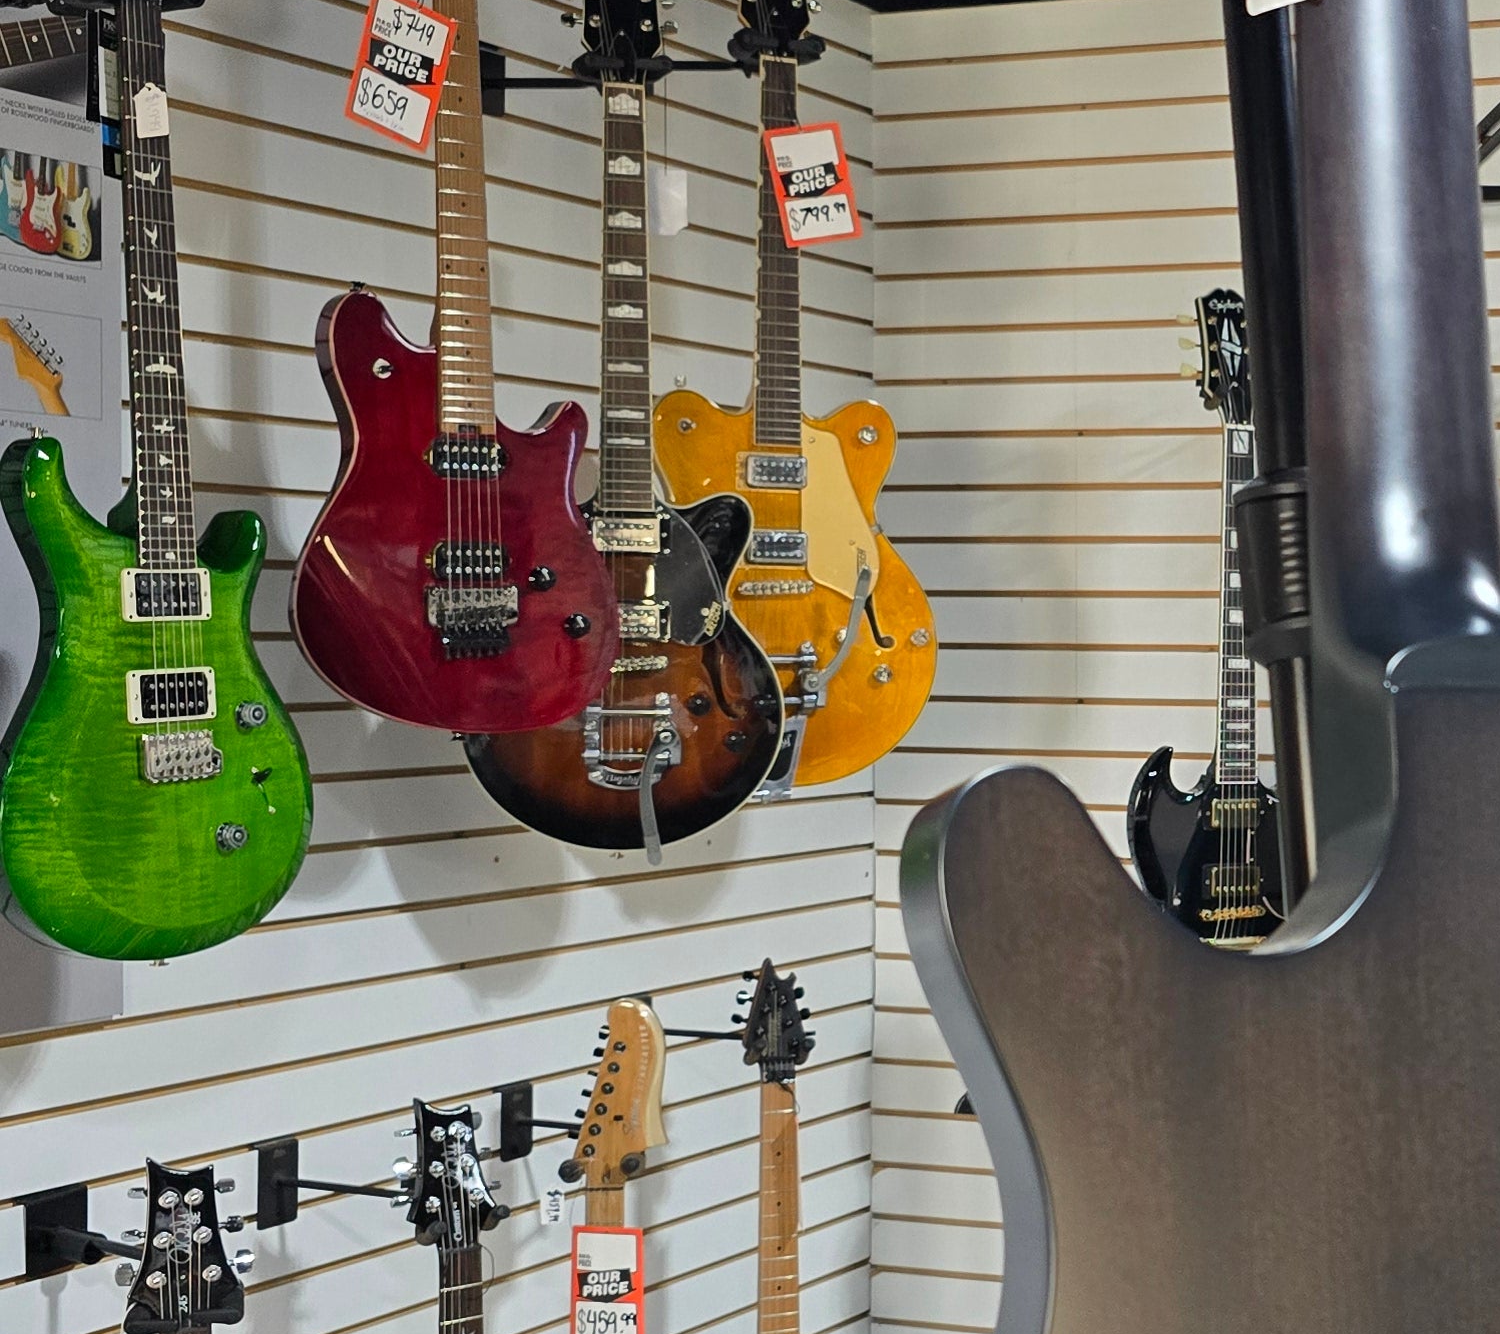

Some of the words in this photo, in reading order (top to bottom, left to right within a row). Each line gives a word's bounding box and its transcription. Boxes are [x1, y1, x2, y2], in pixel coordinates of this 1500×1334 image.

[374, 22, 392, 38] PRICE
[393, 6, 435, 46] $749
[382, 44, 422, 68] OUR
[373, 54, 429, 83] PRICE
[358, 76, 409, 121] $659
[788, 174, 836, 197] PRICE
[791, 165, 826, 184] OUR
[582, 1280, 630, 1298] PRICE
[587, 1270, 621, 1285] OUR
